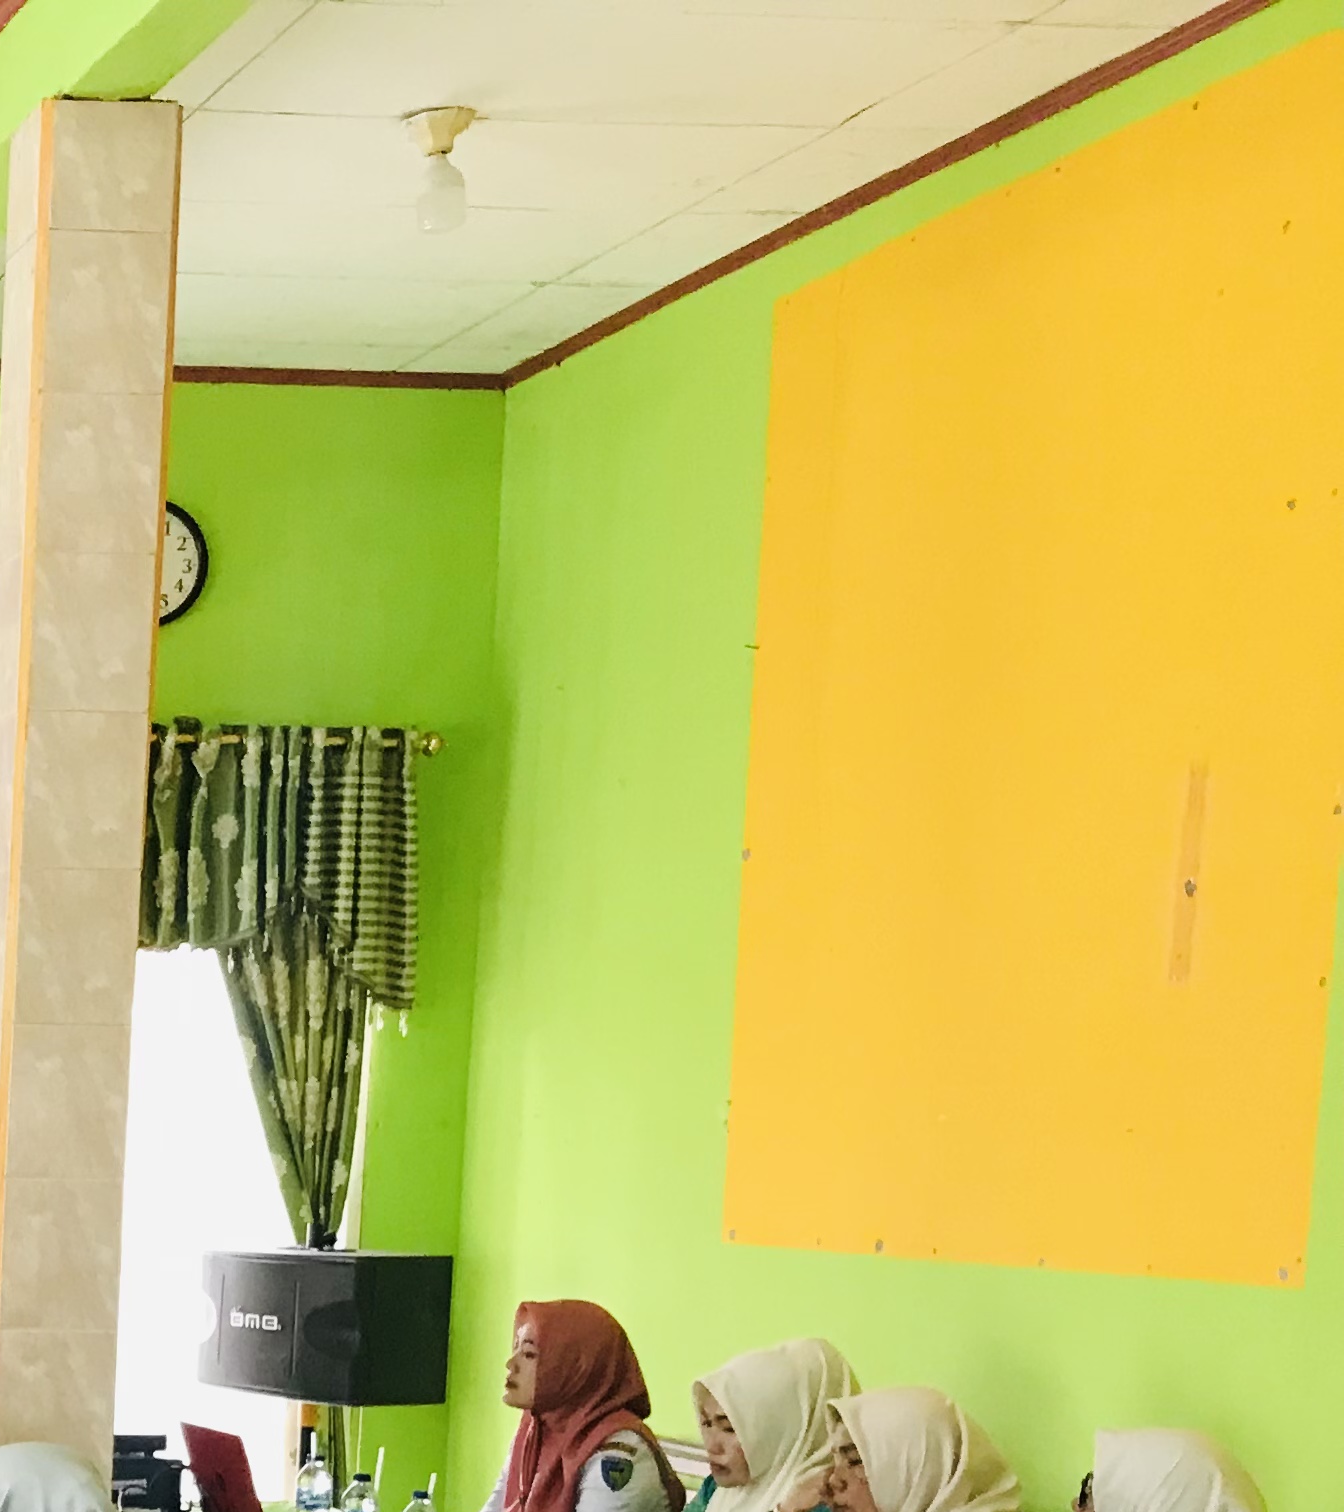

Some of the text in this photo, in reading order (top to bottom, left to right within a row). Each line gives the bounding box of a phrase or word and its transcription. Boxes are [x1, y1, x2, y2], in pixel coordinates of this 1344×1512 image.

[176, 536, 187, 551] 2
[182, 558, 192, 574] 3
[174, 578, 184, 593] 4
